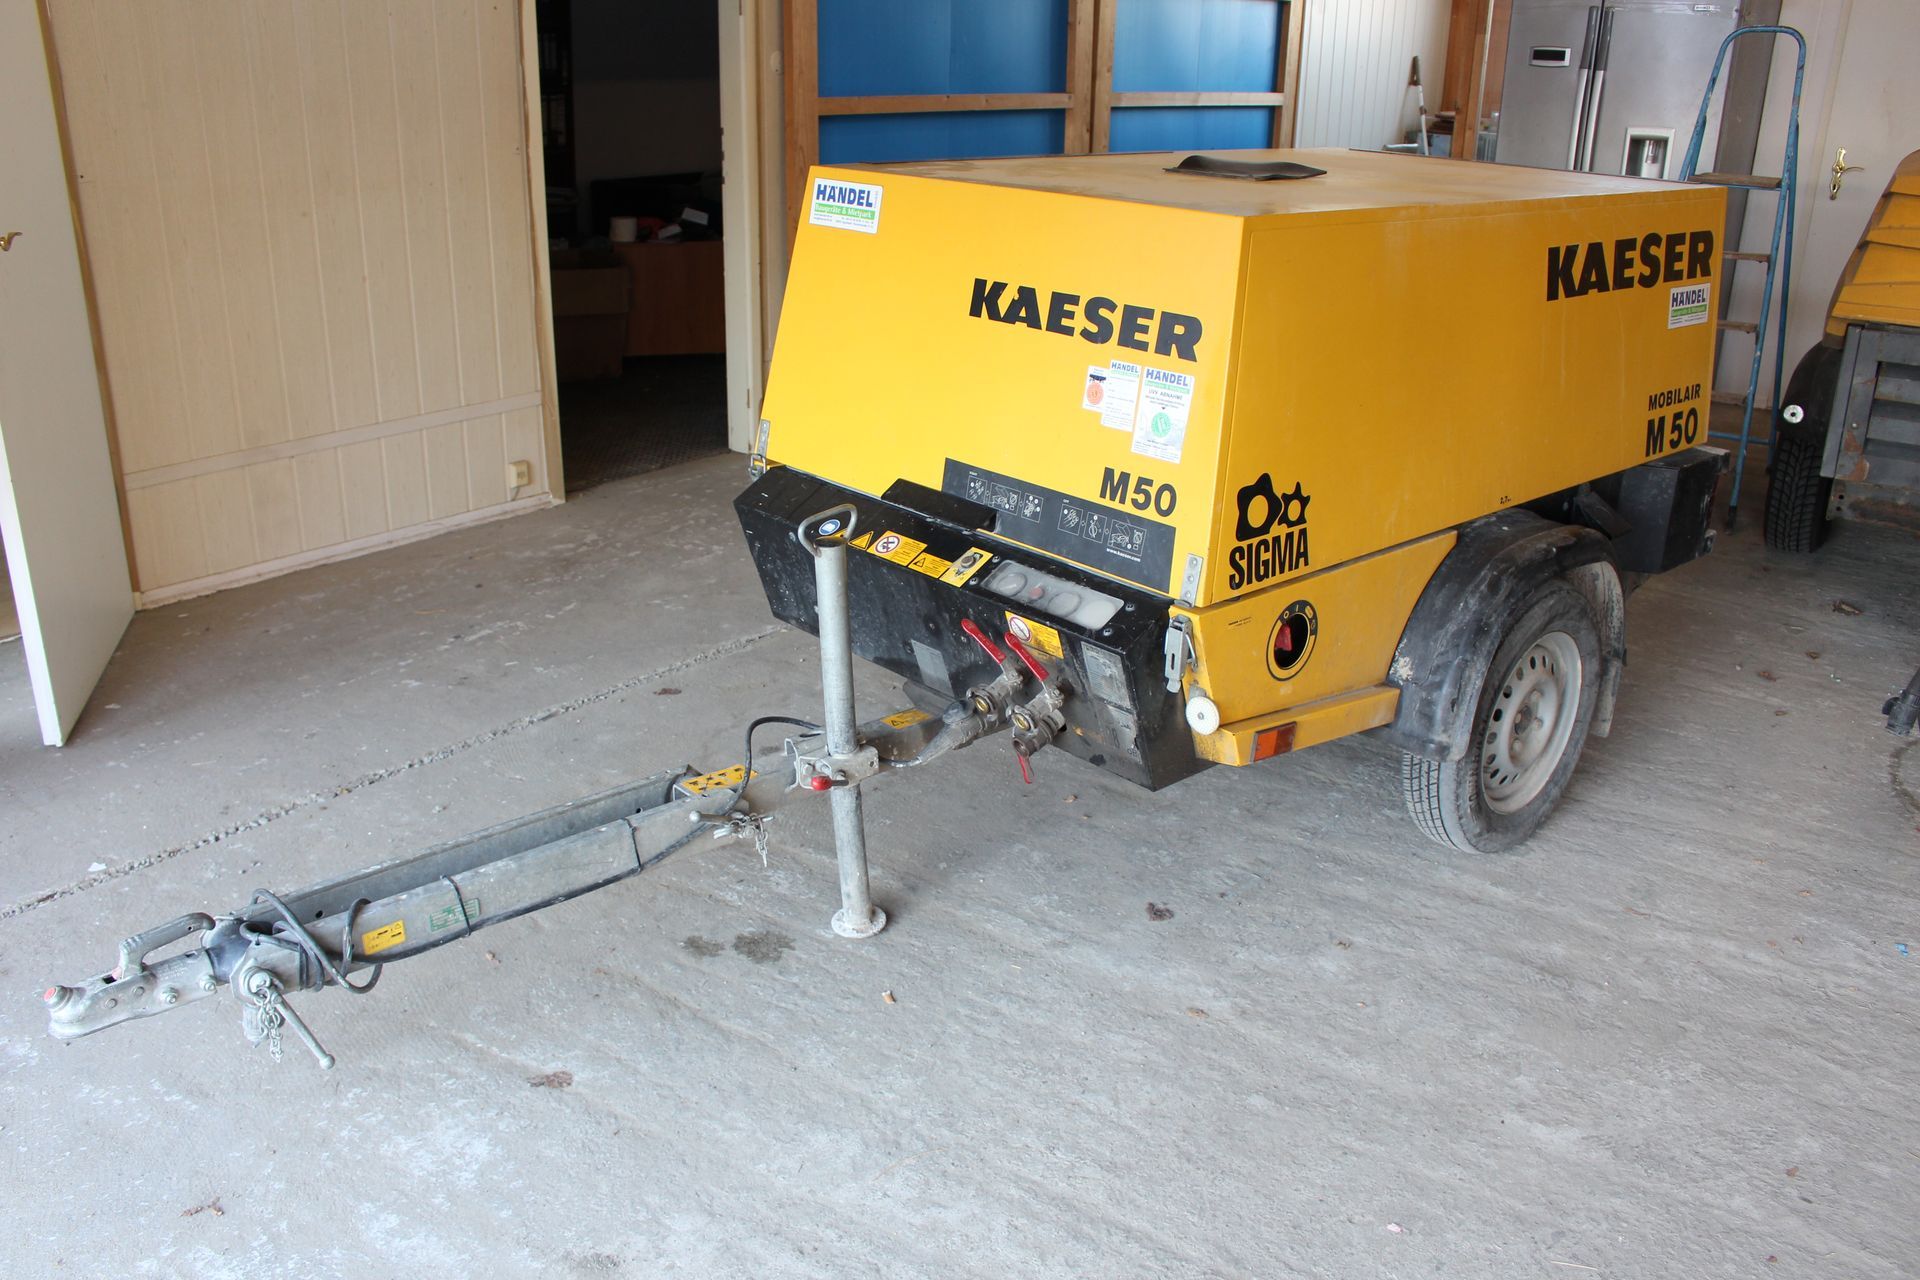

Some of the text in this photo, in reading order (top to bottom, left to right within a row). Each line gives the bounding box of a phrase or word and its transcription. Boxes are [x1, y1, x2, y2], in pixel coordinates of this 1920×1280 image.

[816, 184, 873, 208] HÄNDEL
[1546, 230, 1714, 301] KAESER
[968, 278, 1203, 362] KAESER
[1672, 288, 1706, 308] HÄNDEL
[1648, 383, 1701, 411] MOBILAIR
[1099, 466, 1177, 518] M50
[1229, 527, 1309, 591] SIGMA
